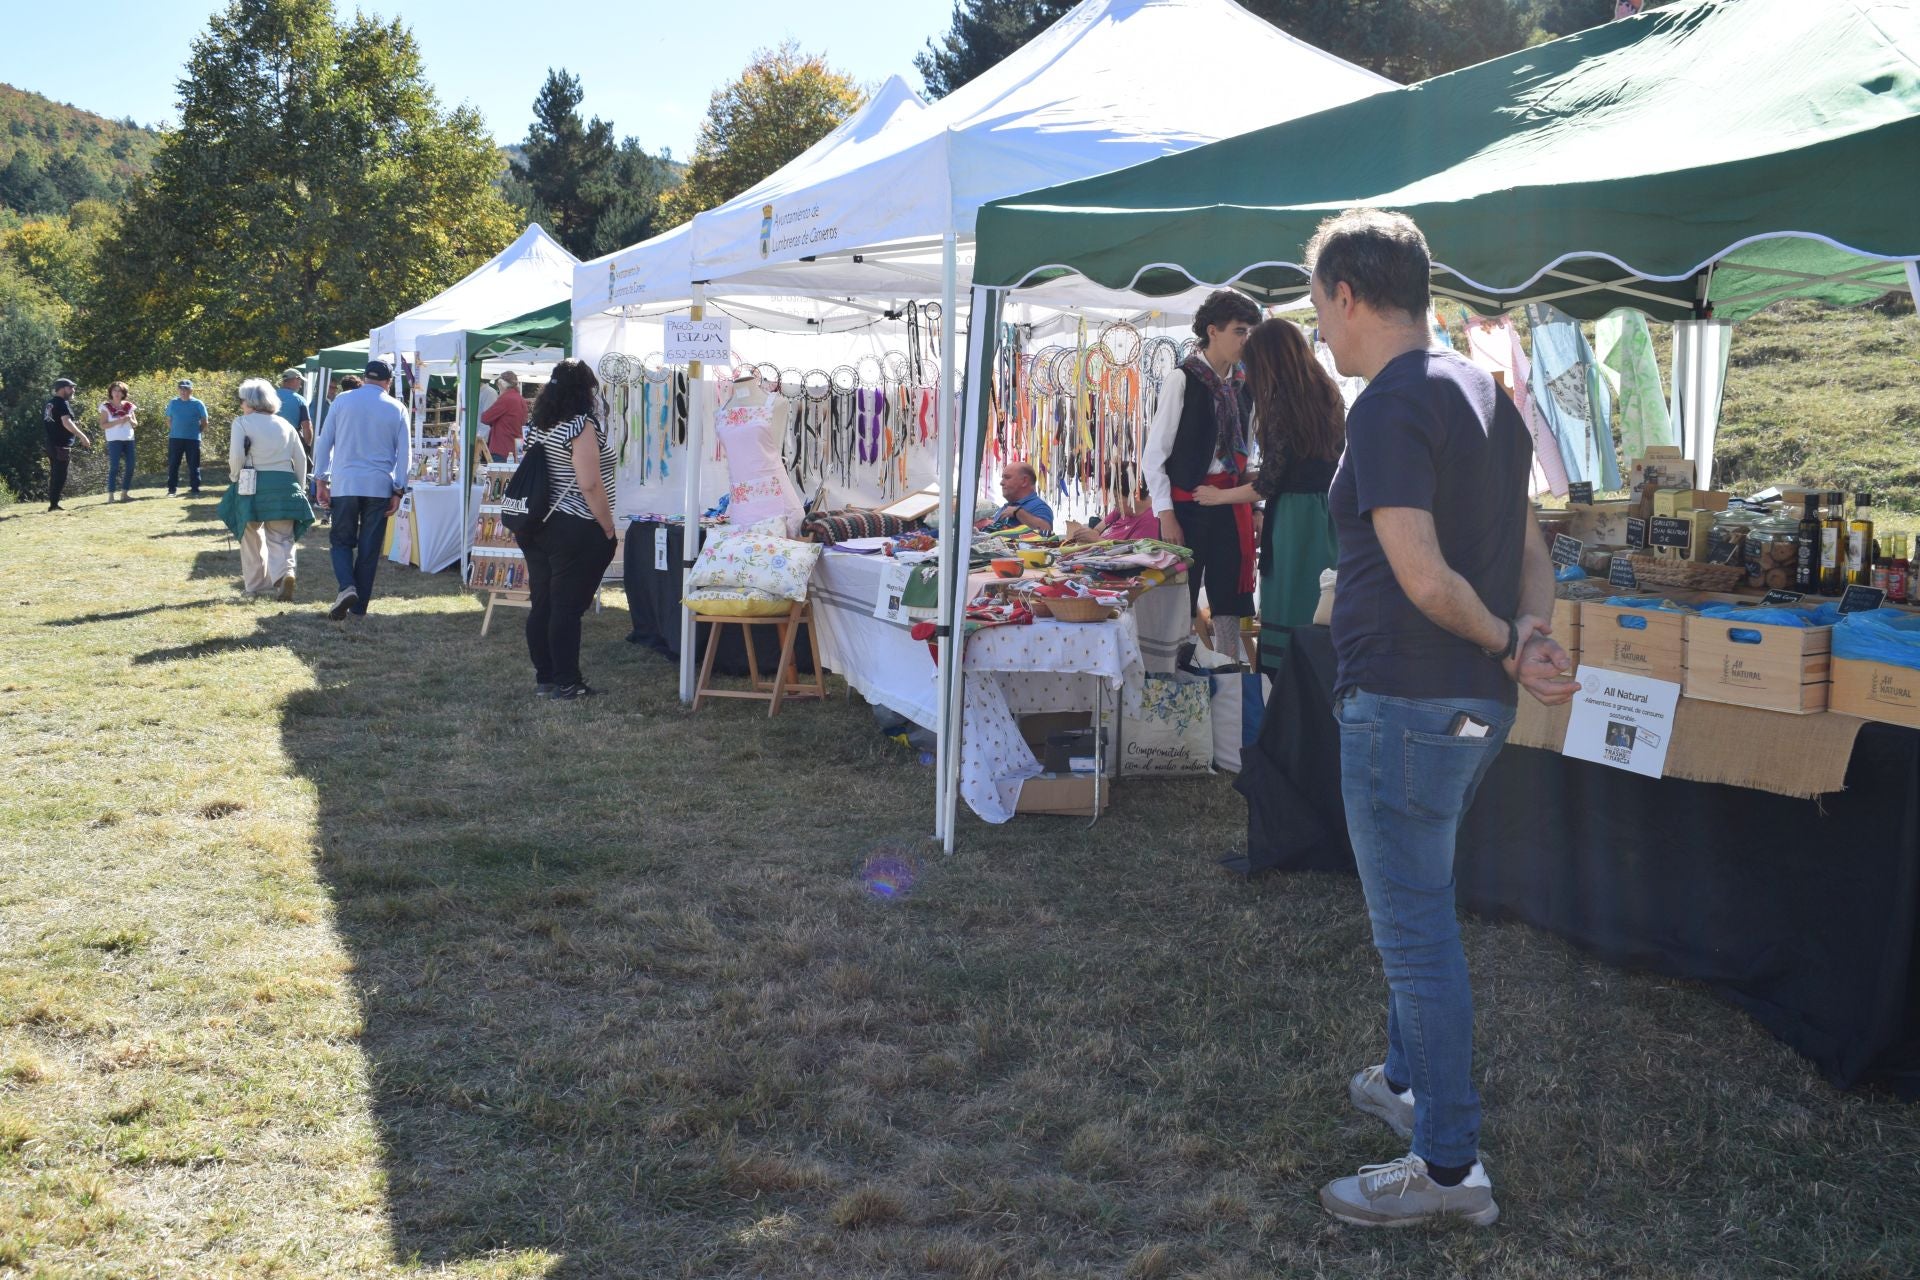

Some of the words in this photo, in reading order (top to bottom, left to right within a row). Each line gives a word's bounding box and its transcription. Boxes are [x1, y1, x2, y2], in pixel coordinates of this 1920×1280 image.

[802, 229, 809, 245] de
[809, 227, 838, 243] Cameros
[667, 320, 694, 331] PAGOS
[702, 321, 722, 331] CON
[677, 333, 723, 343] BIZUM
[1621, 652, 1648, 663] NATURAL
[1731, 669, 1762, 681] NATURAL
[1603, 687, 1615, 697] All
[1617, 689, 1648, 704] Natural
[1880, 686, 1912, 698] NATURAL
[1641, 709, 1665, 719] consumo
[1127, 741, 1191, 760] Comprometidos
